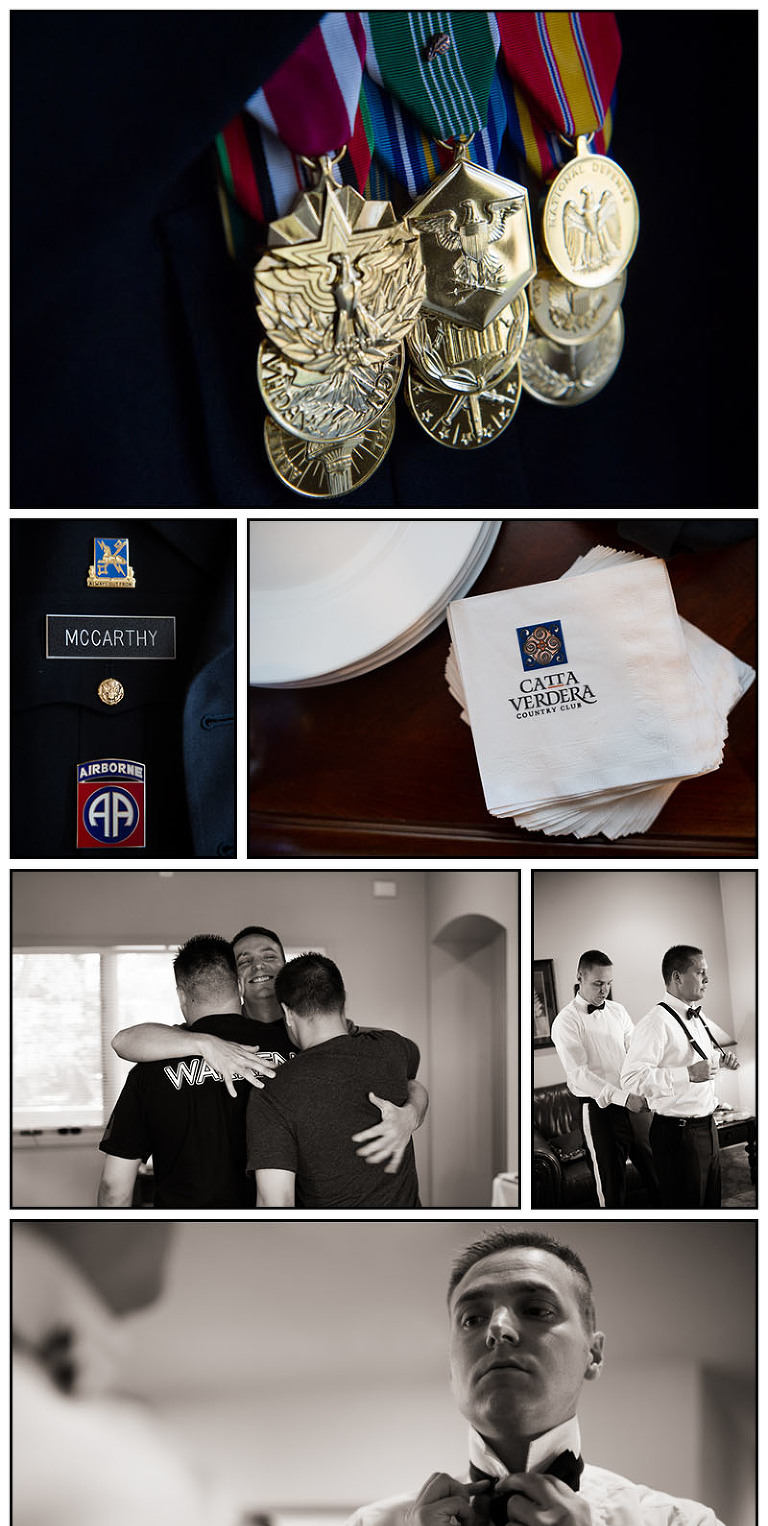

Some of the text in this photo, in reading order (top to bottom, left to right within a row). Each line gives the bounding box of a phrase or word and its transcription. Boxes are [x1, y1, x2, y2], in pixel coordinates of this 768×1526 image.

[548, 162, 631, 228] NATIONAL DEFENSE
[65, 629, 158, 647] MCCARTHY
[519, 671, 579, 693] CATTA
[508, 684, 597, 711] VERDERA
[516, 702, 582, 719] COUNTRY CLUB
[80, 762, 143, 779] AIRBORNE
[88, 791, 134, 837] AA
